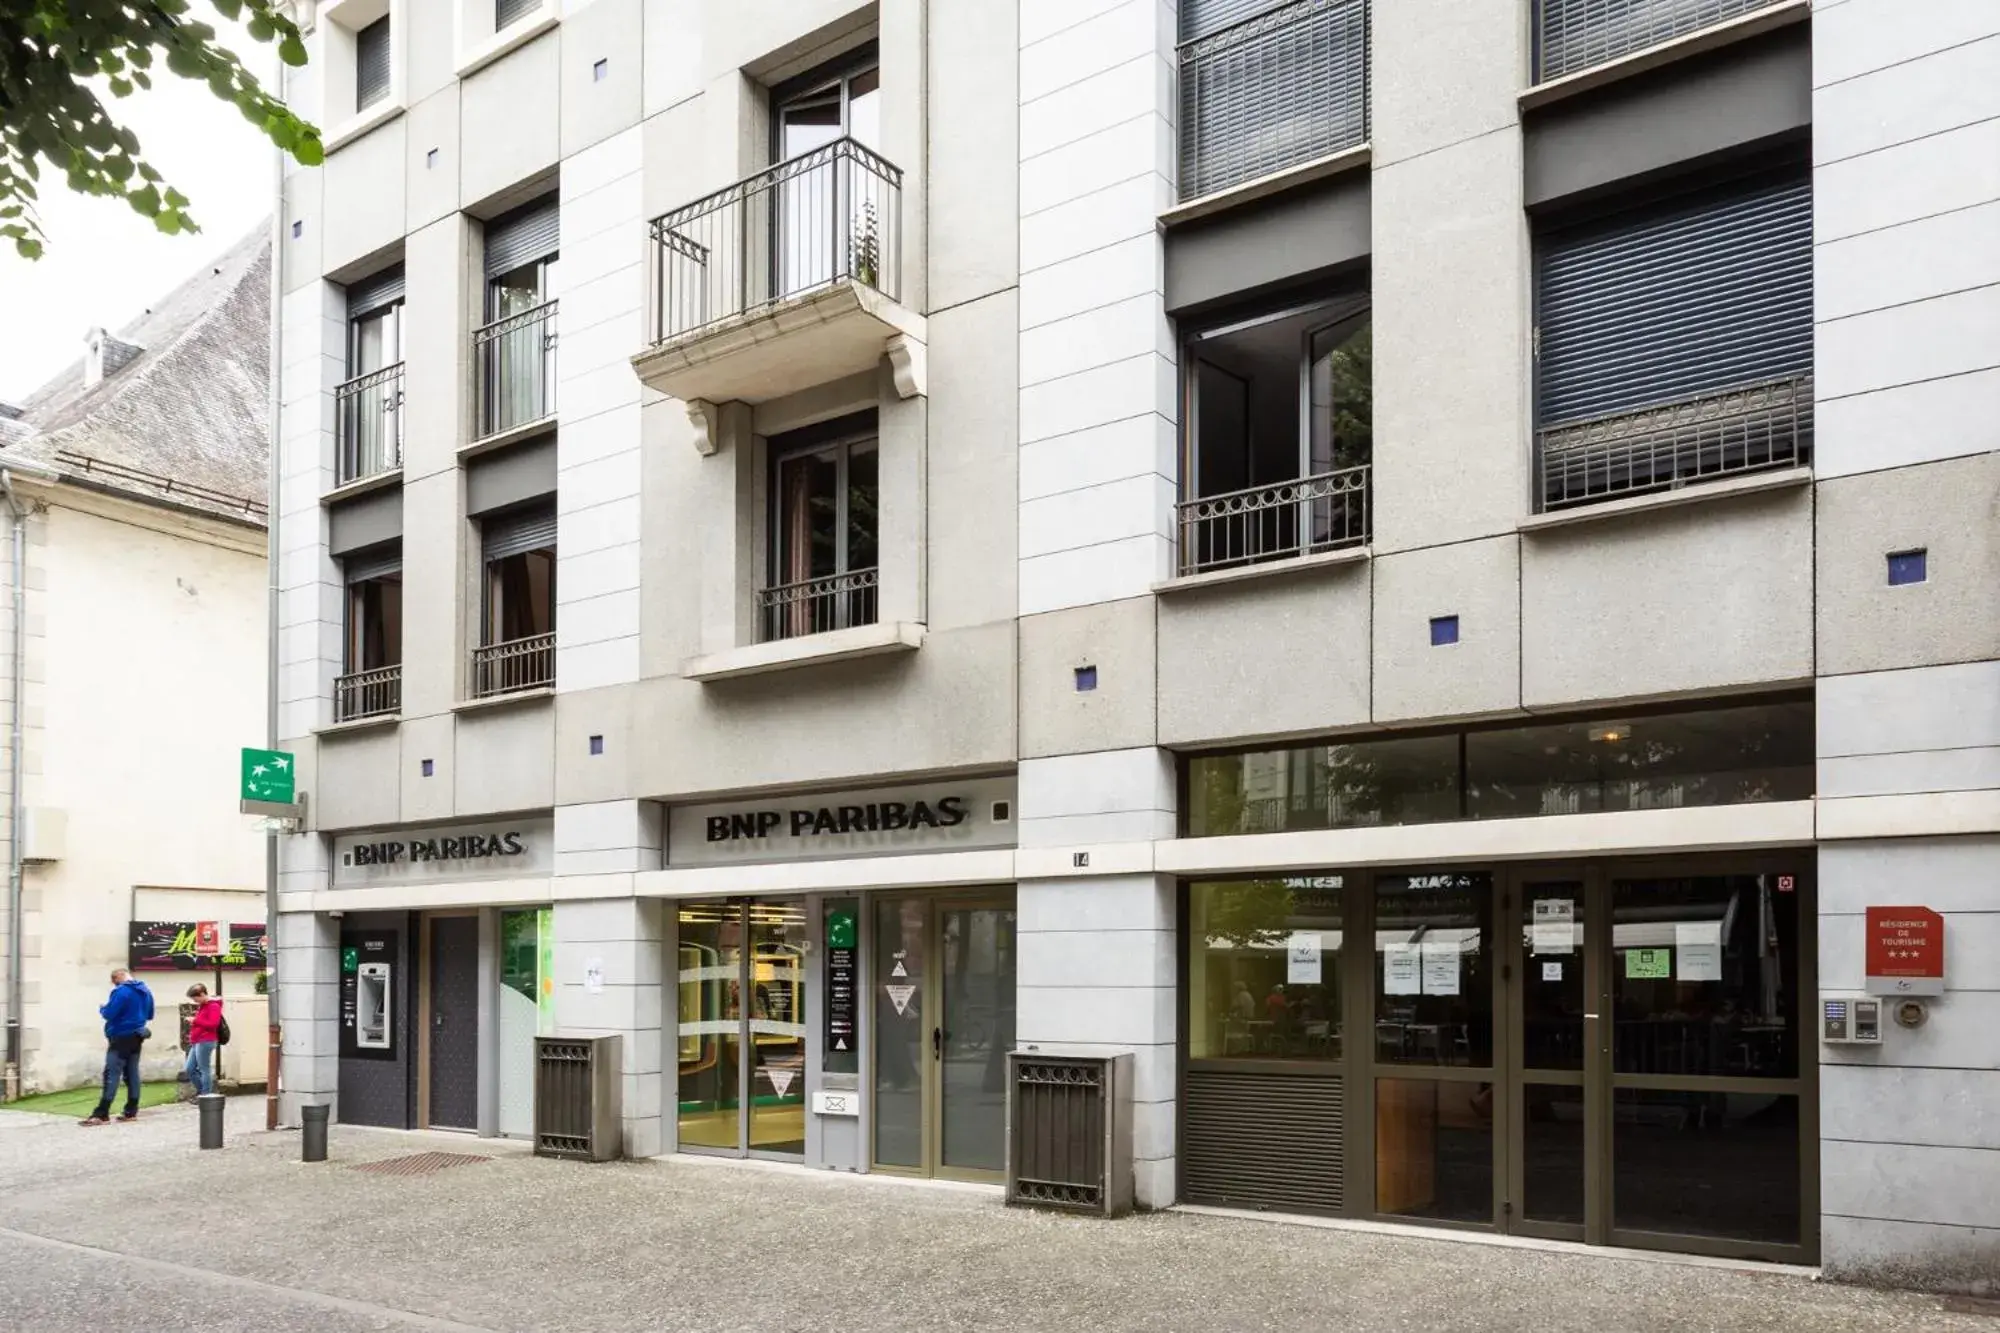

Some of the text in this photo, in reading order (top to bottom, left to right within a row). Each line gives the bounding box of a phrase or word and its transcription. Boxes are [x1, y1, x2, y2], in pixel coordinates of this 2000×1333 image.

[706, 796, 966, 843] BNP PARIBAS
[353, 832, 523, 866] BNP PARIBAS
[1075, 853, 1089, 866] 14
[1879, 918, 1929, 928] RÉSIDENCE
[1881, 938, 1927, 946] TOURISME
